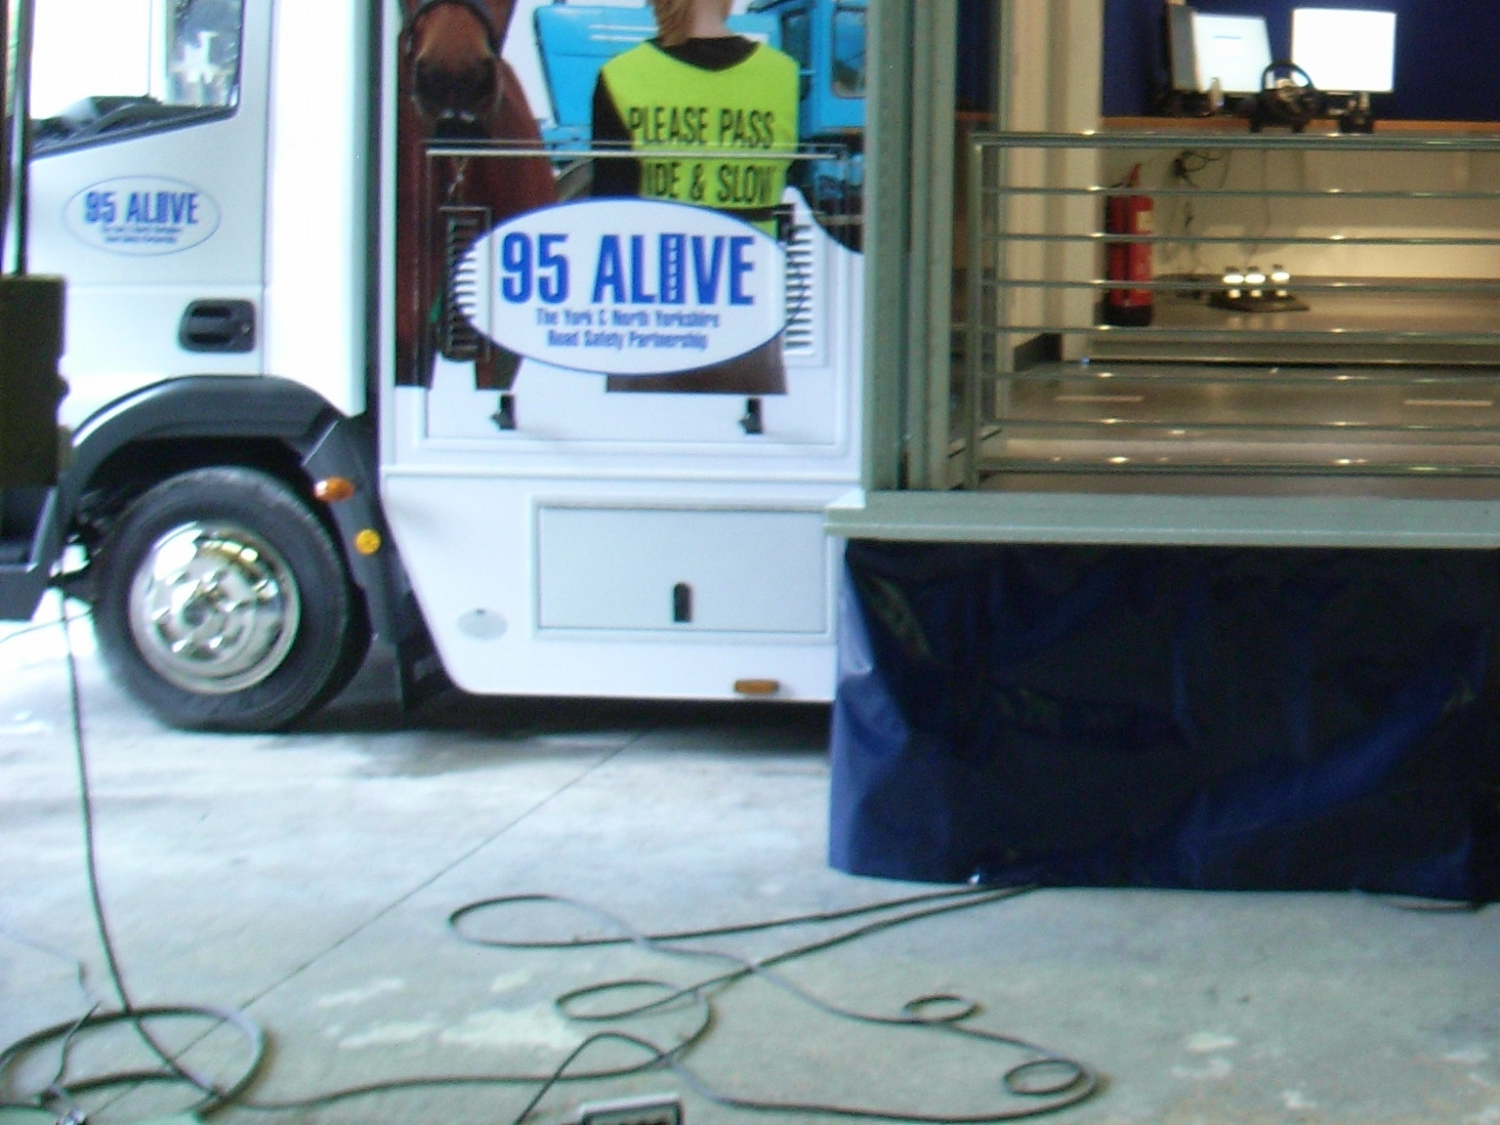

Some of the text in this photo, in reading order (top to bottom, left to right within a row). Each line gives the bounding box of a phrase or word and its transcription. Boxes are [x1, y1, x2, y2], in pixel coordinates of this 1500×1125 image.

[629, 106, 775, 149] PLEASE PASS
[641, 161, 777, 204] IDE & SLOW
[85, 191, 199, 224] 95 ALIVE
[501, 231, 755, 305] 95 ALIVE
